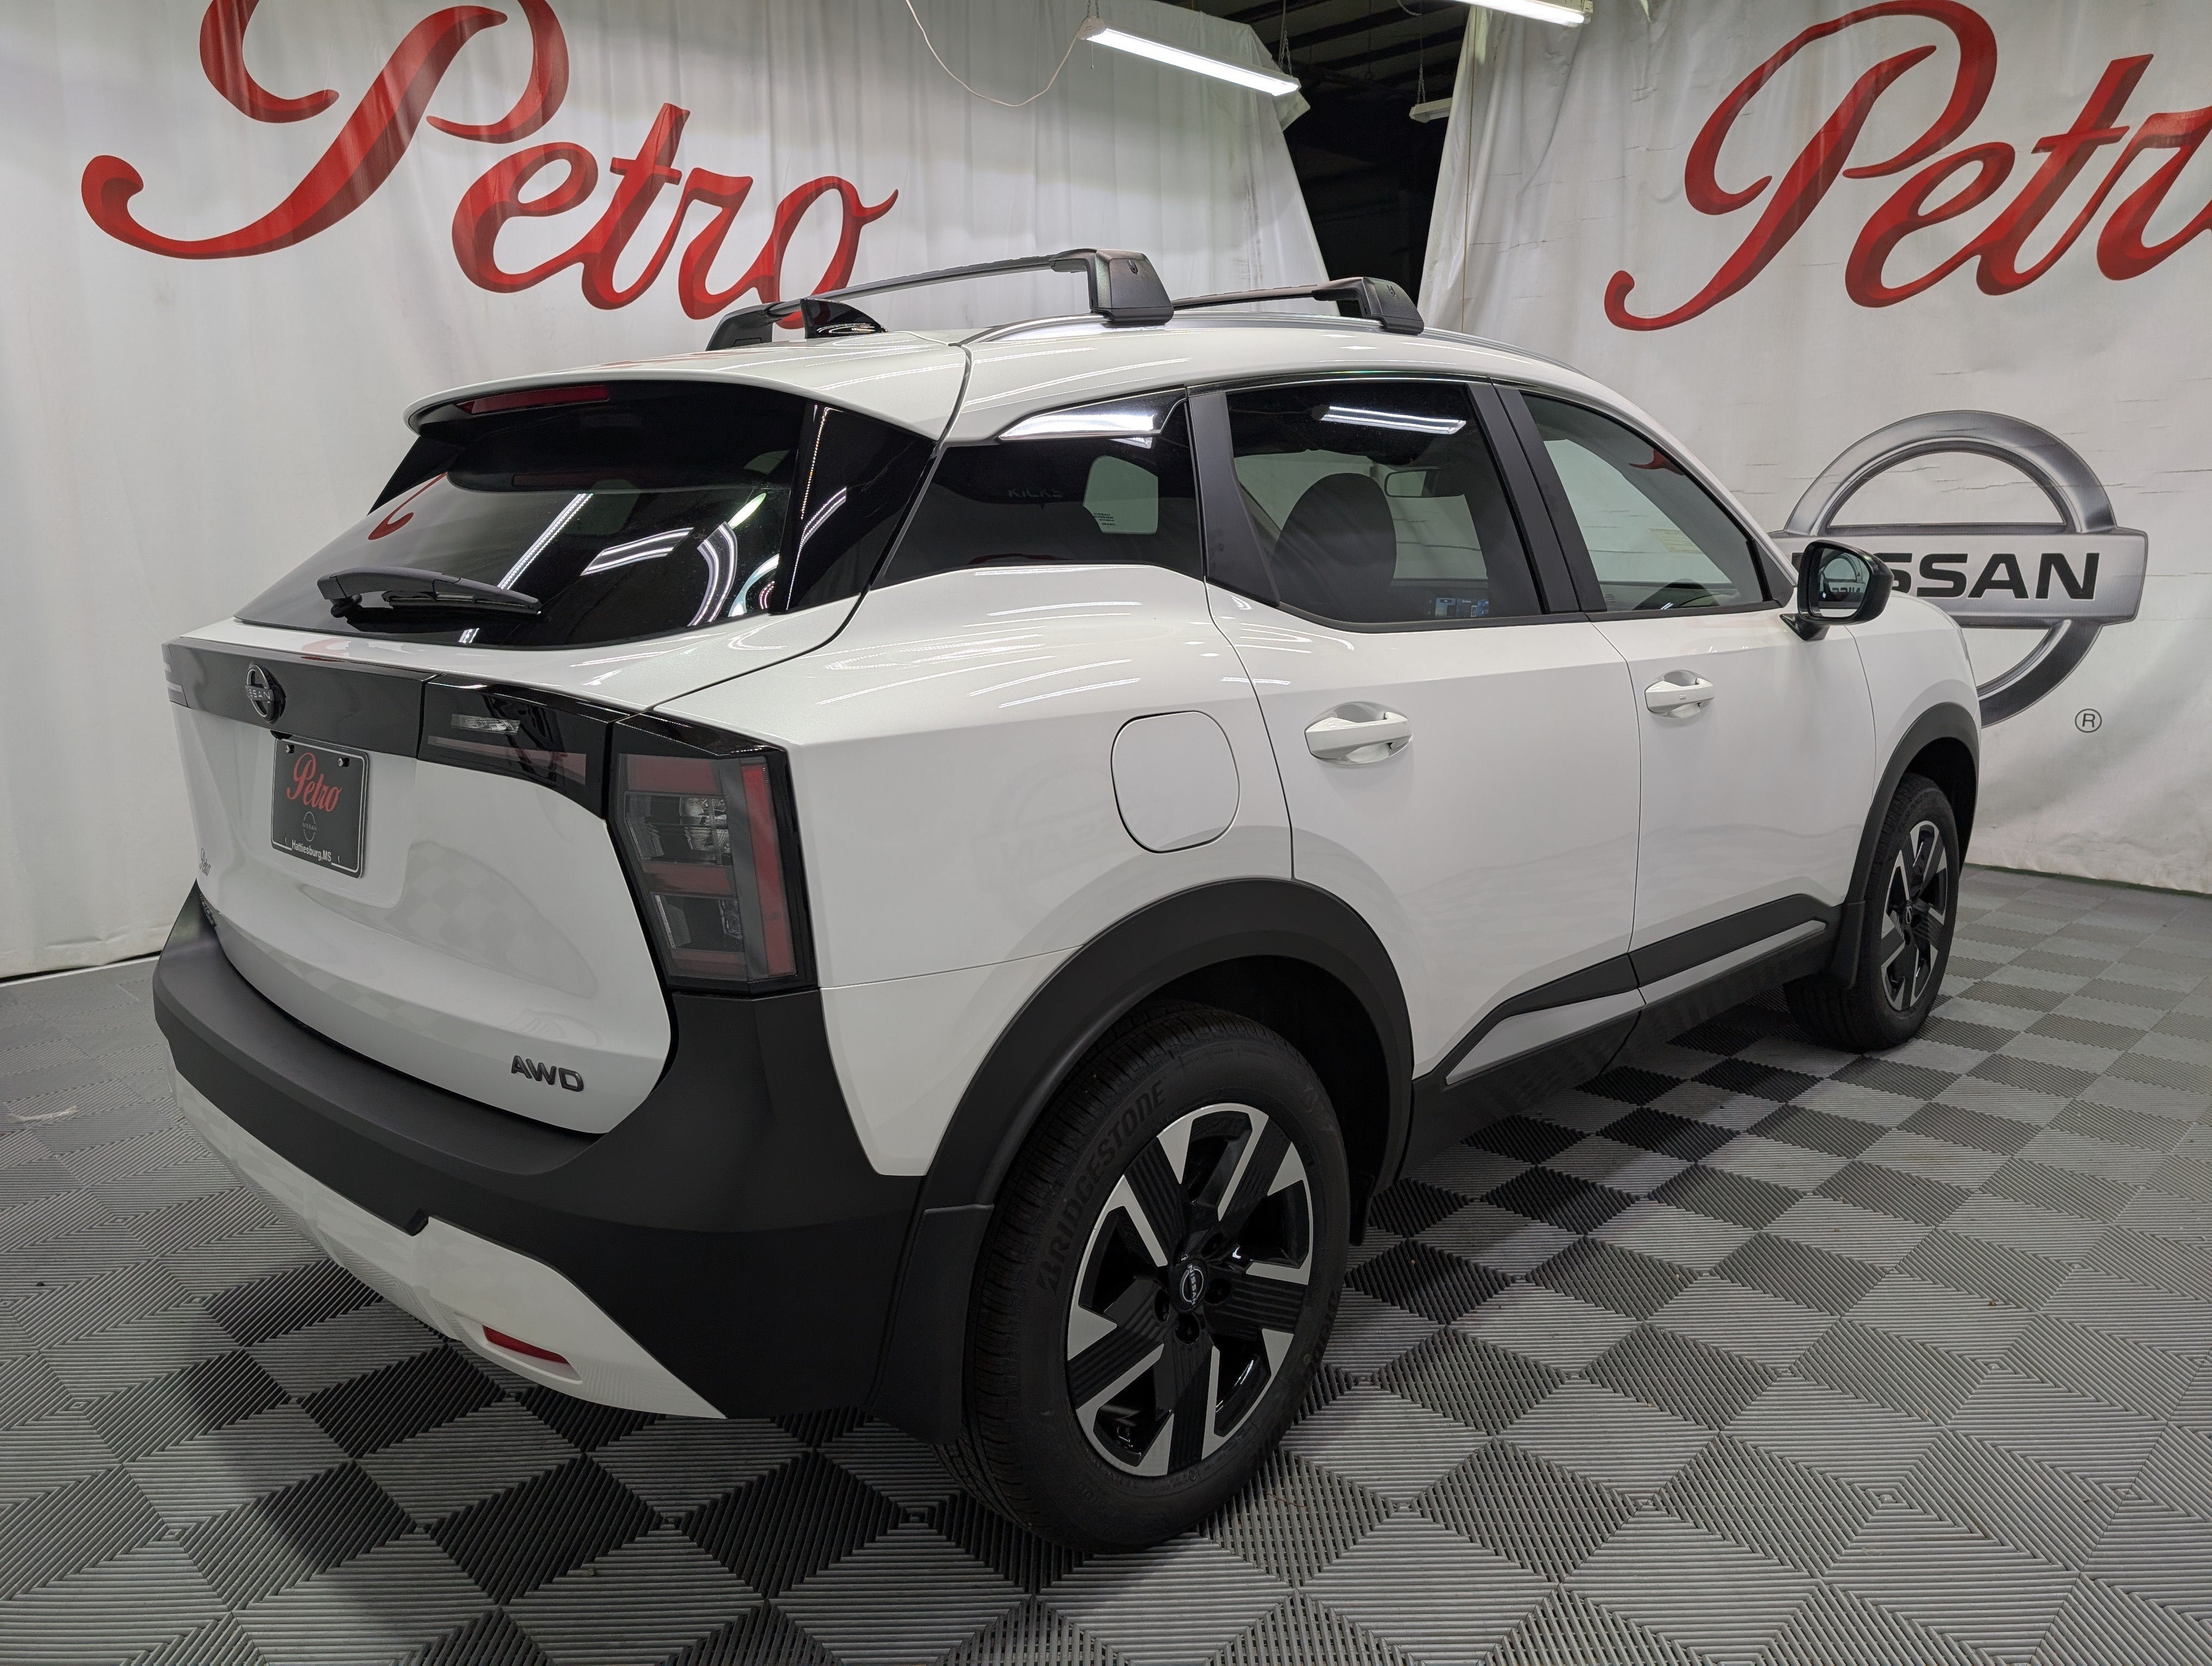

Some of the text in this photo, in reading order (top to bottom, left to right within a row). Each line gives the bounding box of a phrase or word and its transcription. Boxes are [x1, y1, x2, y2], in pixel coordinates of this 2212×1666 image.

[81, 0, 899, 329] Petro
[1604, 0, 2212, 331] Petr
[286, 752, 343, 812] Petro
[302, 822, 317, 831] NISSAN
[511, 1055, 584, 1092] AWD
[1036, 1079, 1167, 1298] BRIDGESTONE
[1187, 1264, 1197, 1305] NISSAN
